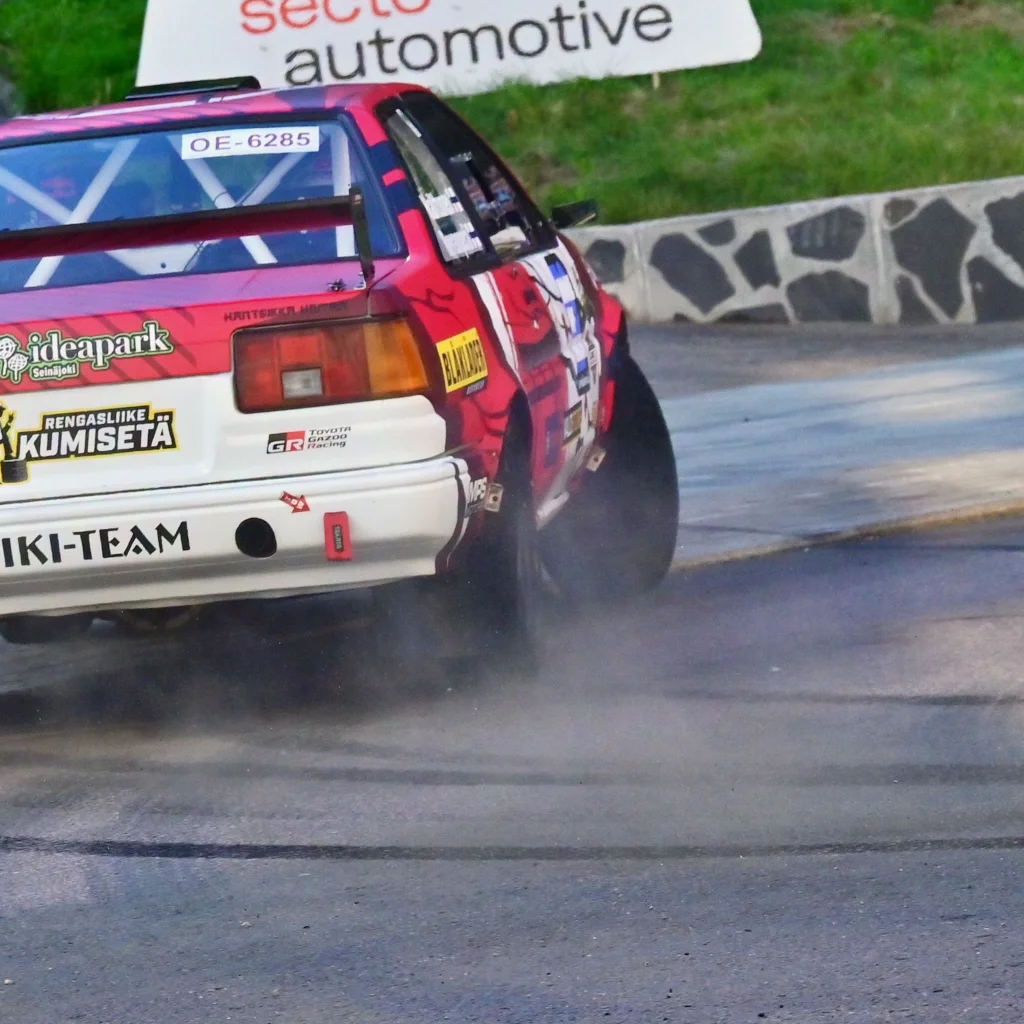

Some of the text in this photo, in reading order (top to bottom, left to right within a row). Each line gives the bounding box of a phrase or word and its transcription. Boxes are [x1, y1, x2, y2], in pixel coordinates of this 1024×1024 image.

[284, 0, 673, 86] automotive
[190, 132, 311, 152] OE-6285
[30, 323, 170, 367] ideapark
[32, 366, 76, 378] Seinäjoki
[45, 408, 147, 430] RENGASLIIKE
[17, 415, 173, 460] KUMISETÄ
[308, 434, 347, 443] GAZOO
[309, 426, 352, 436] TOYOTA
[267, 438, 305, 453] GR
[307, 441, 346, 450] Racing
